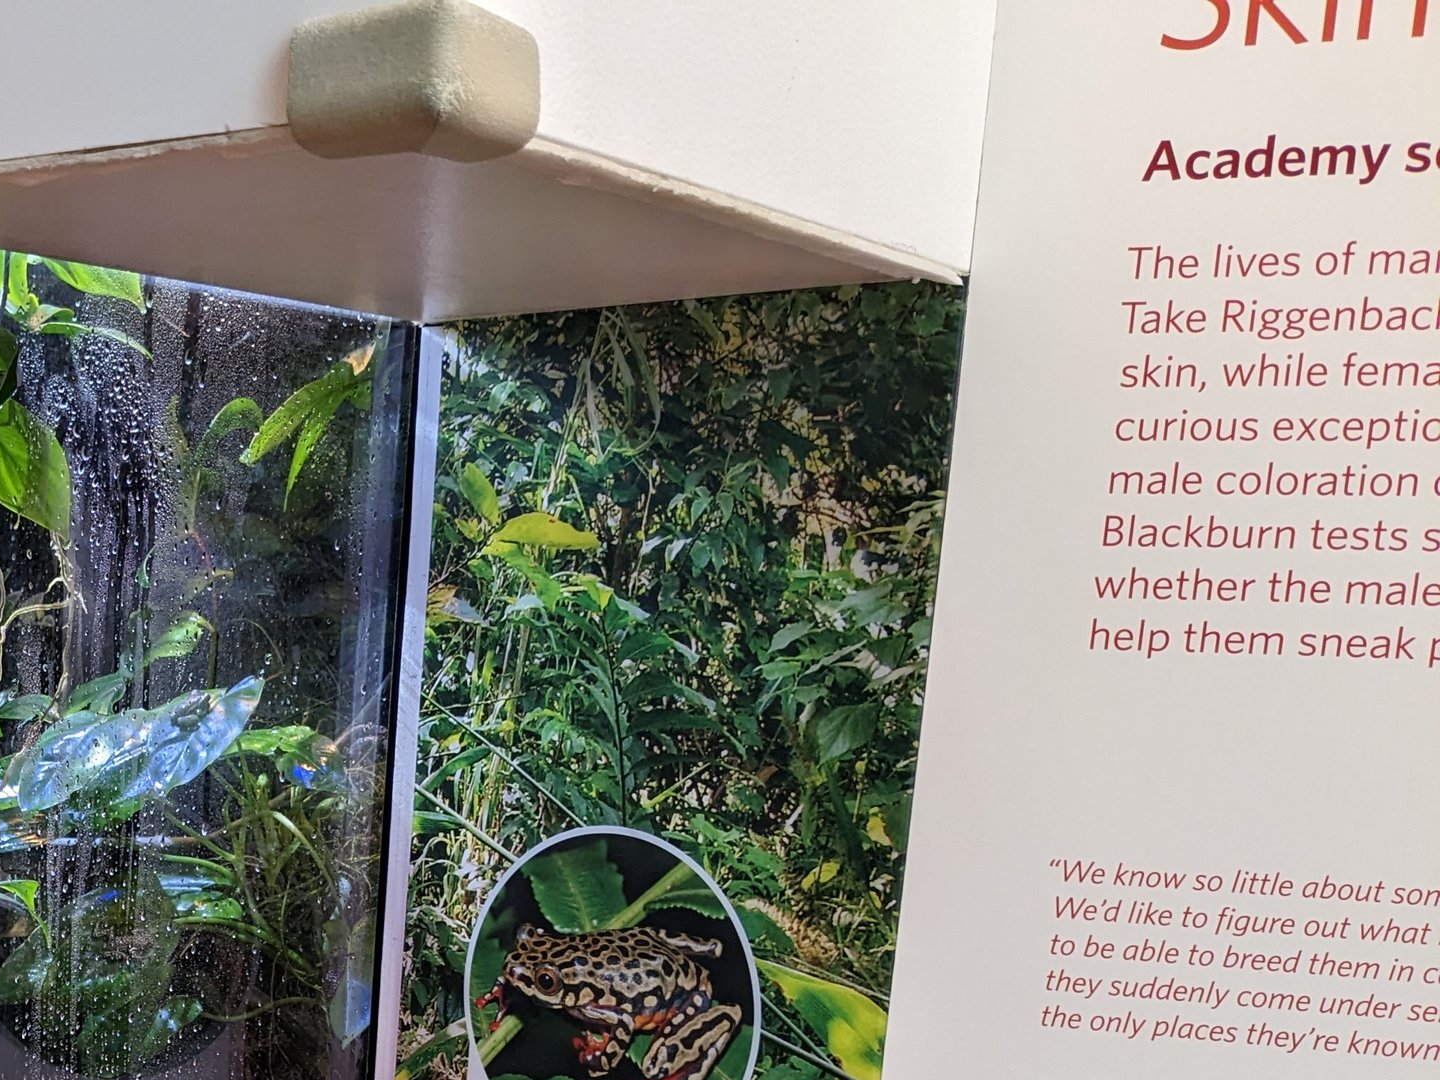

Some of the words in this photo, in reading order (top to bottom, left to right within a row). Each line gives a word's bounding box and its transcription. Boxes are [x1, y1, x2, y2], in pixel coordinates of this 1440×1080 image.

[1141, 134, 1391, 185] Academy
[1405, 142, 1440, 173] s
[1128, 245, 1199, 279] The
[1214, 244, 1300, 278] lives
[1316, 241, 1357, 276] of
[1369, 250, 1440, 274] ma
[1121, 300, 1206, 334] Take
[1120, 354, 1206, 392] skin,
[1223, 352, 1327, 387] while
[1116, 409, 1258, 441] curious
[1109, 462, 1202, 495] male
[1217, 462, 1418, 496] coloration
[1103, 514, 1295, 549] Blackburn
[1311, 520, 1408, 551] tests
[1095, 567, 1256, 601] whether
[1268, 570, 1331, 604] the
[1346, 572, 1440, 606] male
[1090, 618, 1169, 659] help
[1184, 621, 1284, 655] them
[1298, 626, 1416, 659] sneak
[1113, 862, 1187, 889] know
[1192, 875, 1223, 892] so
[1231, 870, 1293, 896] little
[1302, 875, 1385, 903] about
[1056, 896, 1122, 922] We’d
[1128, 901, 1172, 926] like
[1182, 906, 1208, 928] to
[1215, 907, 1295, 937] figure
[1304, 917, 1351, 939] out
[1361, 918, 1432, 945] what
[1051, 934, 1075, 956] to
[1083, 935, 1115, 959] be
[1123, 939, 1179, 964] able
[1188, 944, 1214, 966] to
[1223, 945, 1302, 973] breed
[1309, 952, 1380, 979] them
[1388, 958, 1414, 982] in
[1423, 967, 1440, 984] c
[1046, 969, 1103, 999] they
[1108, 976, 1230, 1009] suddenly
[1237, 991, 1311, 1012] come
[1319, 994, 1402, 1019] under
[1407, 1005, 1440, 1023] se
[1041, 1005, 1082, 1029] the
[1090, 1011, 1146, 1039] only
[1151, 1015, 1238, 1043] places
[1247, 1022, 1339, 1053] they’re
